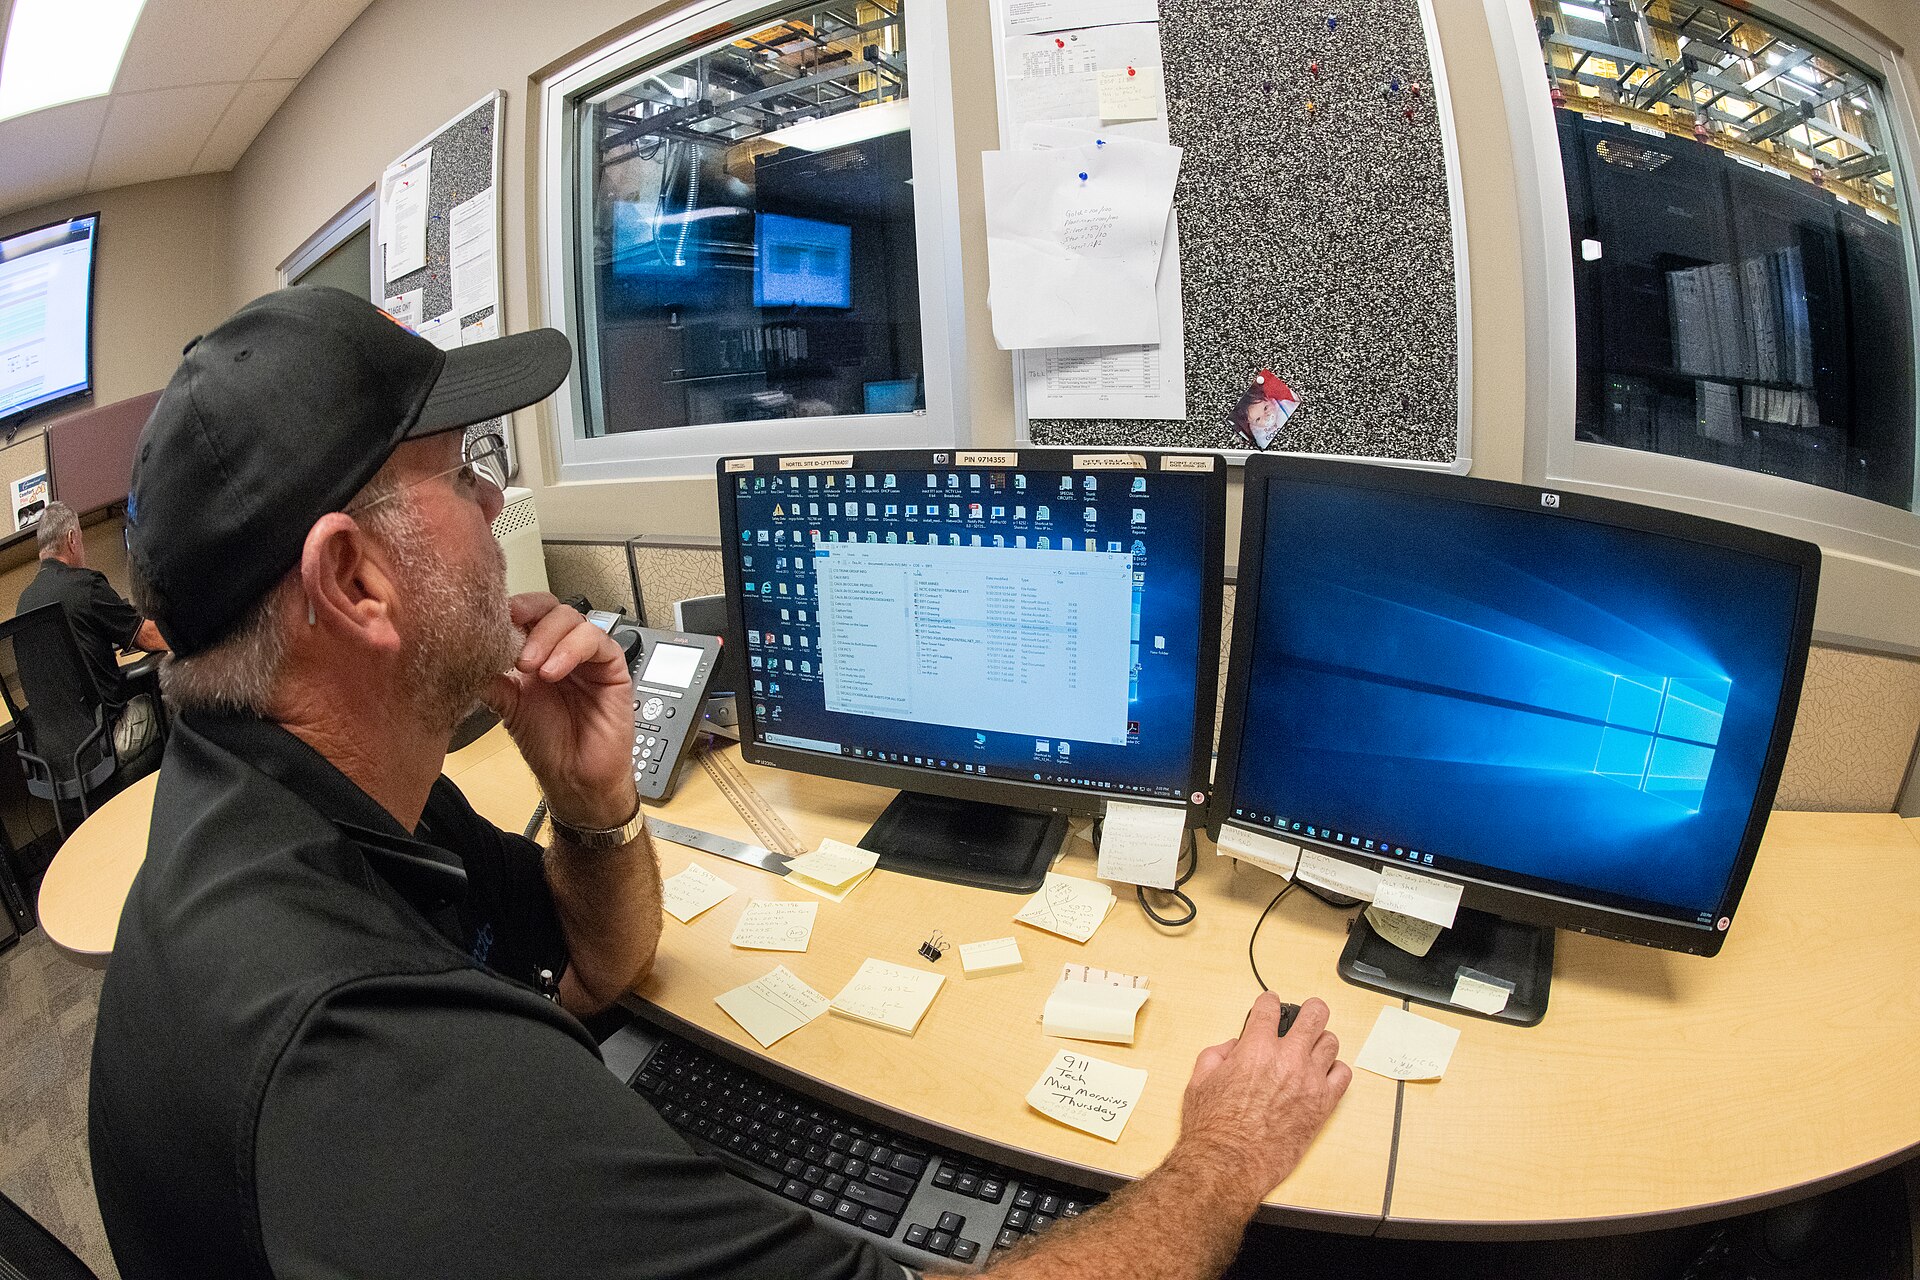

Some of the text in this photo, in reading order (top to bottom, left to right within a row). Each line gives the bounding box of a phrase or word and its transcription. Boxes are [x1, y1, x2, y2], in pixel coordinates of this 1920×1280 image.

[1063, 1055, 1089, 1072] 911
[1044, 1076, 1071, 1091] Mid
[1055, 1067, 1086, 1085] Tech
[1051, 1093, 1117, 1122] Thursday
